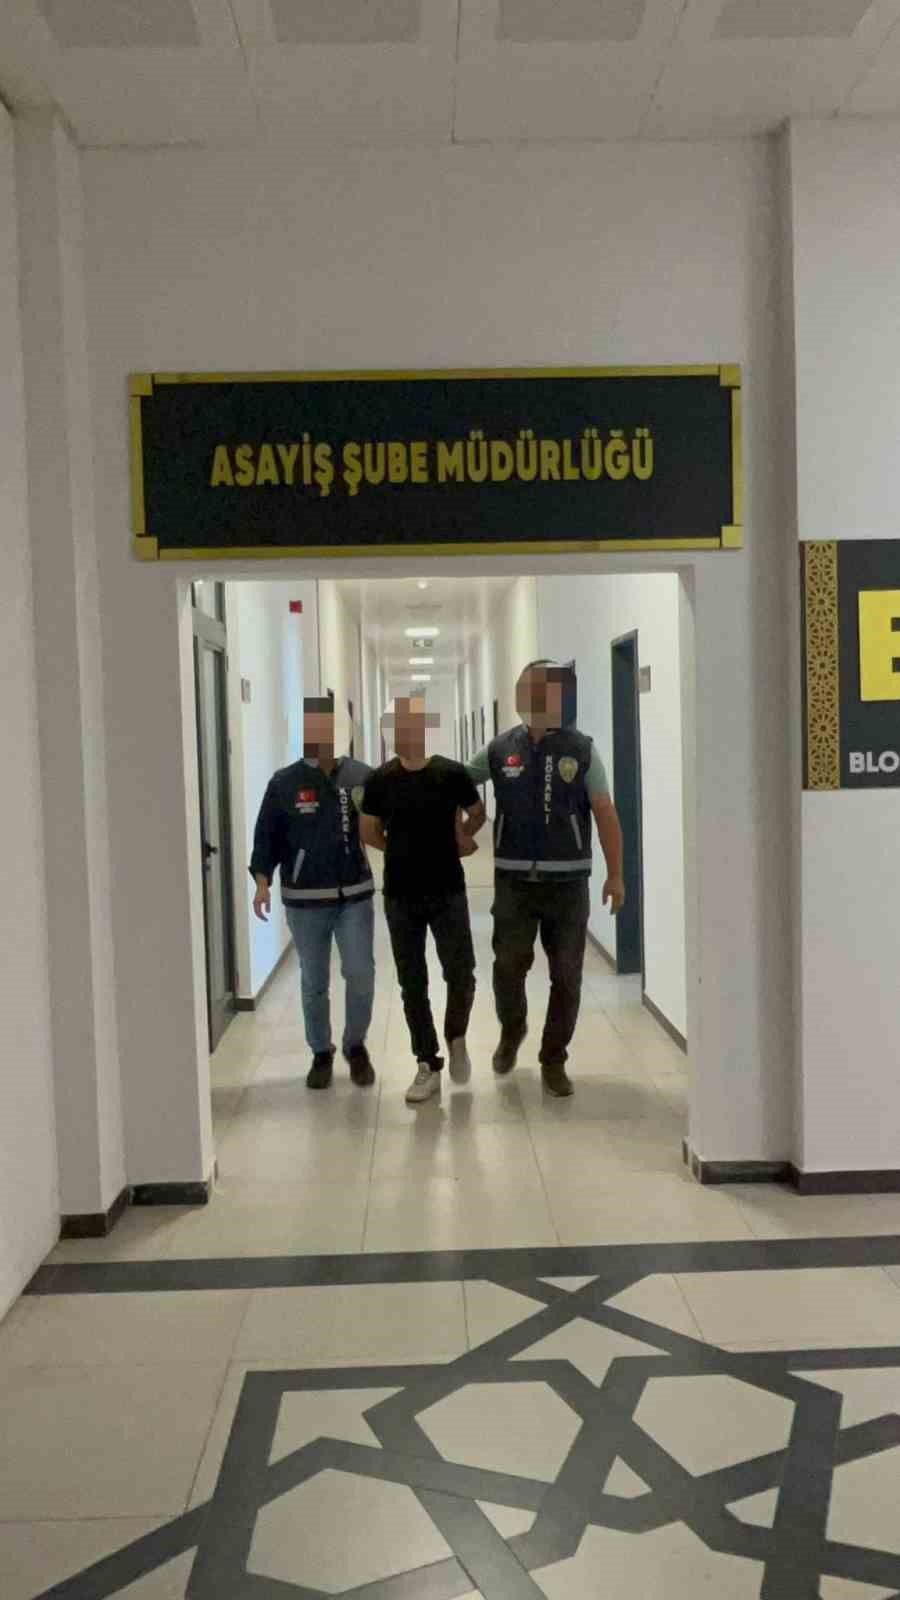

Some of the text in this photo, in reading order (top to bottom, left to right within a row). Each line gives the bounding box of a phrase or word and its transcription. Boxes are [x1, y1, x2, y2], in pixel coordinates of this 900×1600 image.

[210, 428, 654, 496] ASAYİŞ ŞUBE MÜDÜRLÜĞÜ
